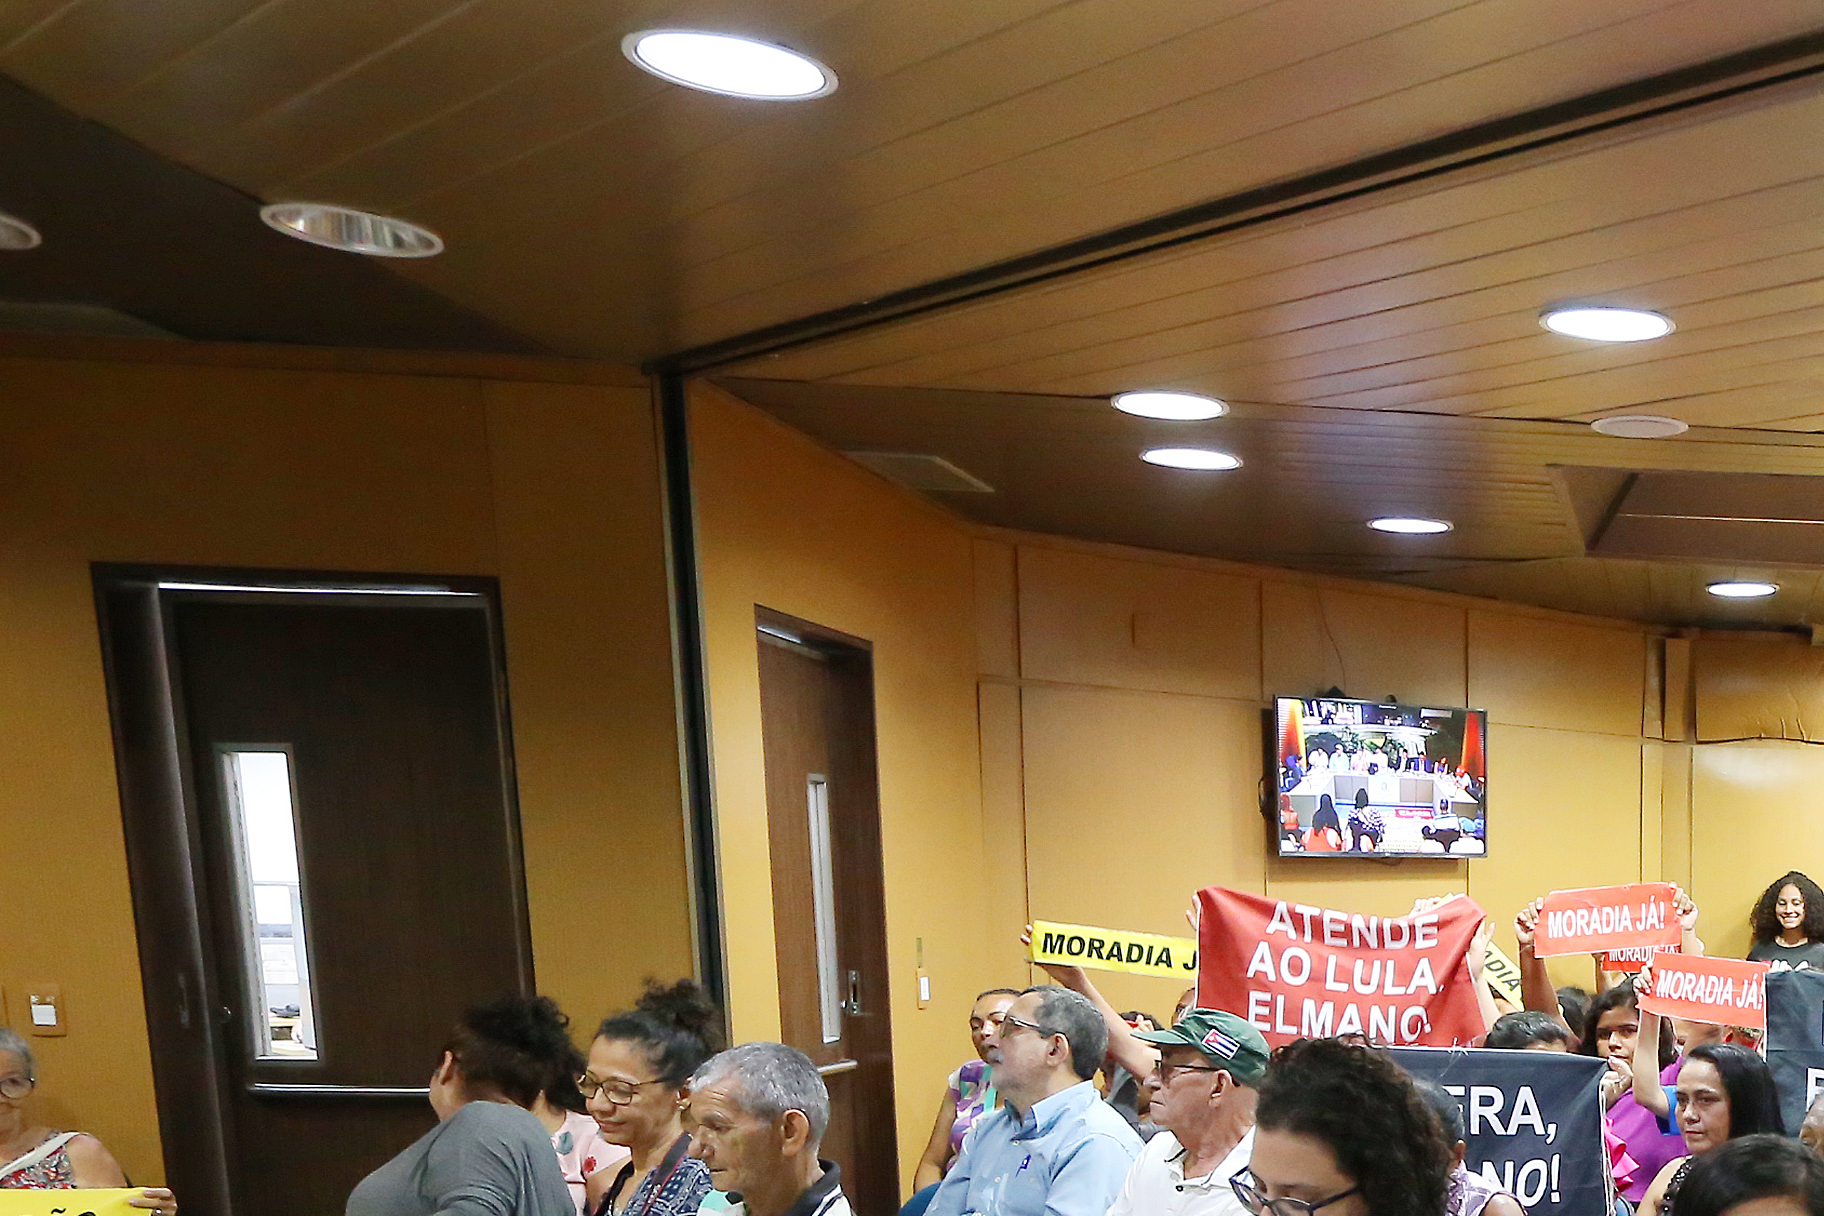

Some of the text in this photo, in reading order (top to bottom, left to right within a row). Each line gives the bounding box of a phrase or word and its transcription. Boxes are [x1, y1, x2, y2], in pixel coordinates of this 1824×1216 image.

[1265, 900, 1440, 950] ATENDE
[1547, 895, 1665, 939] MORADIA JÁ!
[1042, 932, 1173, 969] MORADIA
[1246, 940, 1312, 987] AO
[1656, 969, 1734, 1007] MORADIA
